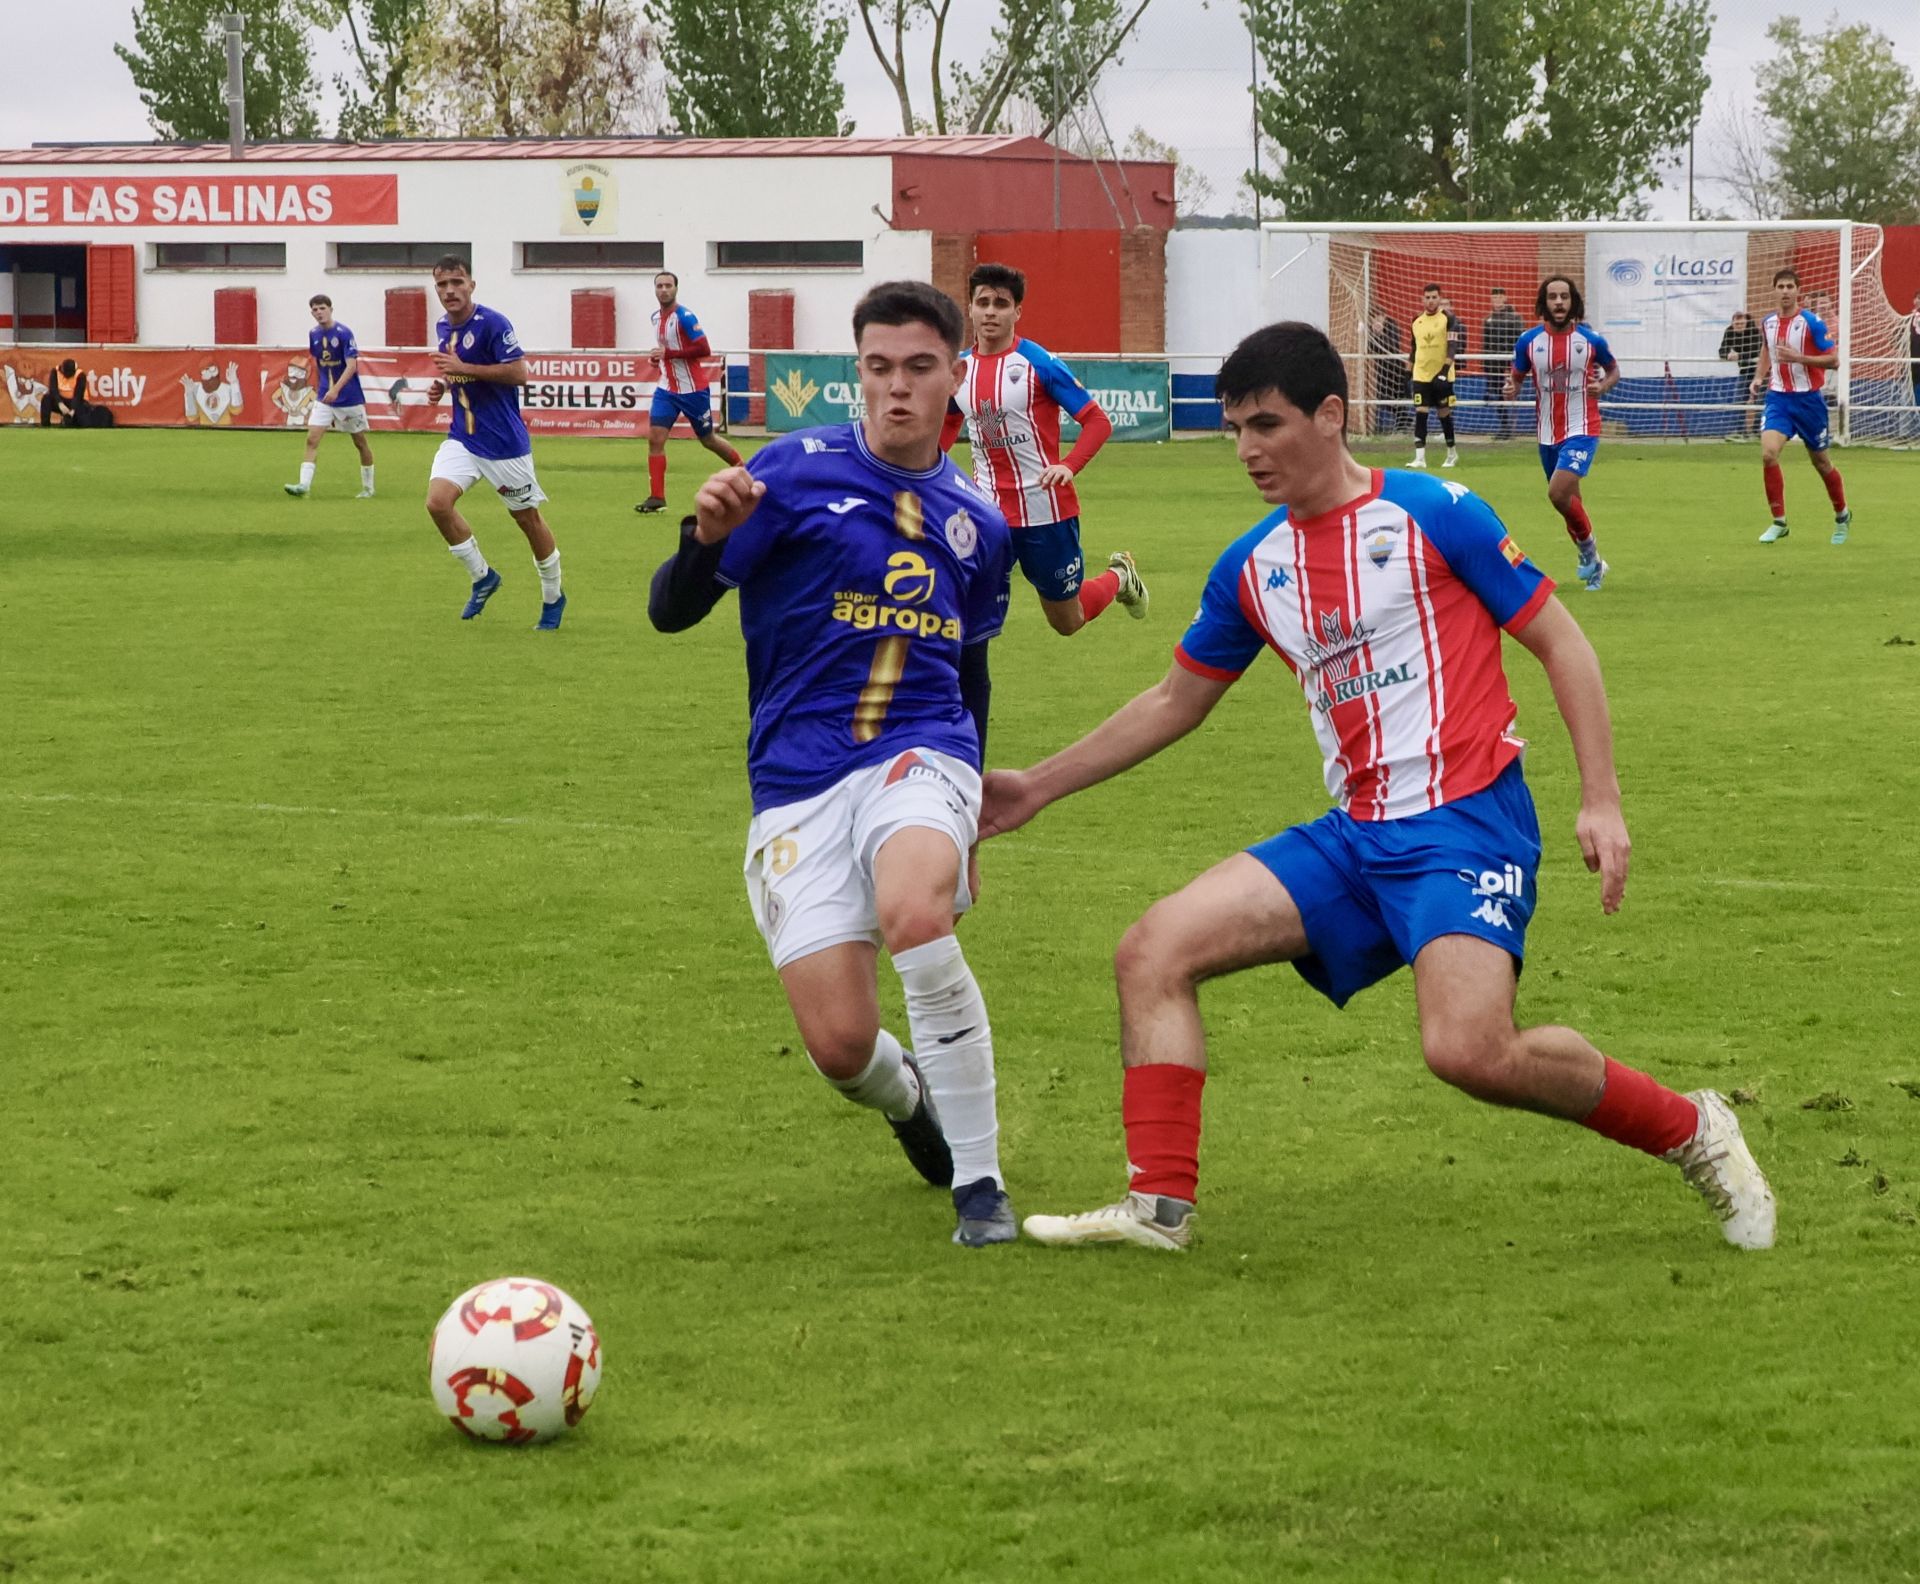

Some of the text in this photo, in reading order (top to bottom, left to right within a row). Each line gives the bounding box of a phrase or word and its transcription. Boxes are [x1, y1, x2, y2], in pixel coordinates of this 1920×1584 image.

[0, 184, 333, 223] DE LAS SALINAS
[86, 367, 147, 406] telfy
[525, 360, 636, 377] MIENTO DE
[523, 384, 637, 409] ESILLAS
[1334, 662, 1418, 704] RURAL
[1479, 863, 1523, 897] oil
